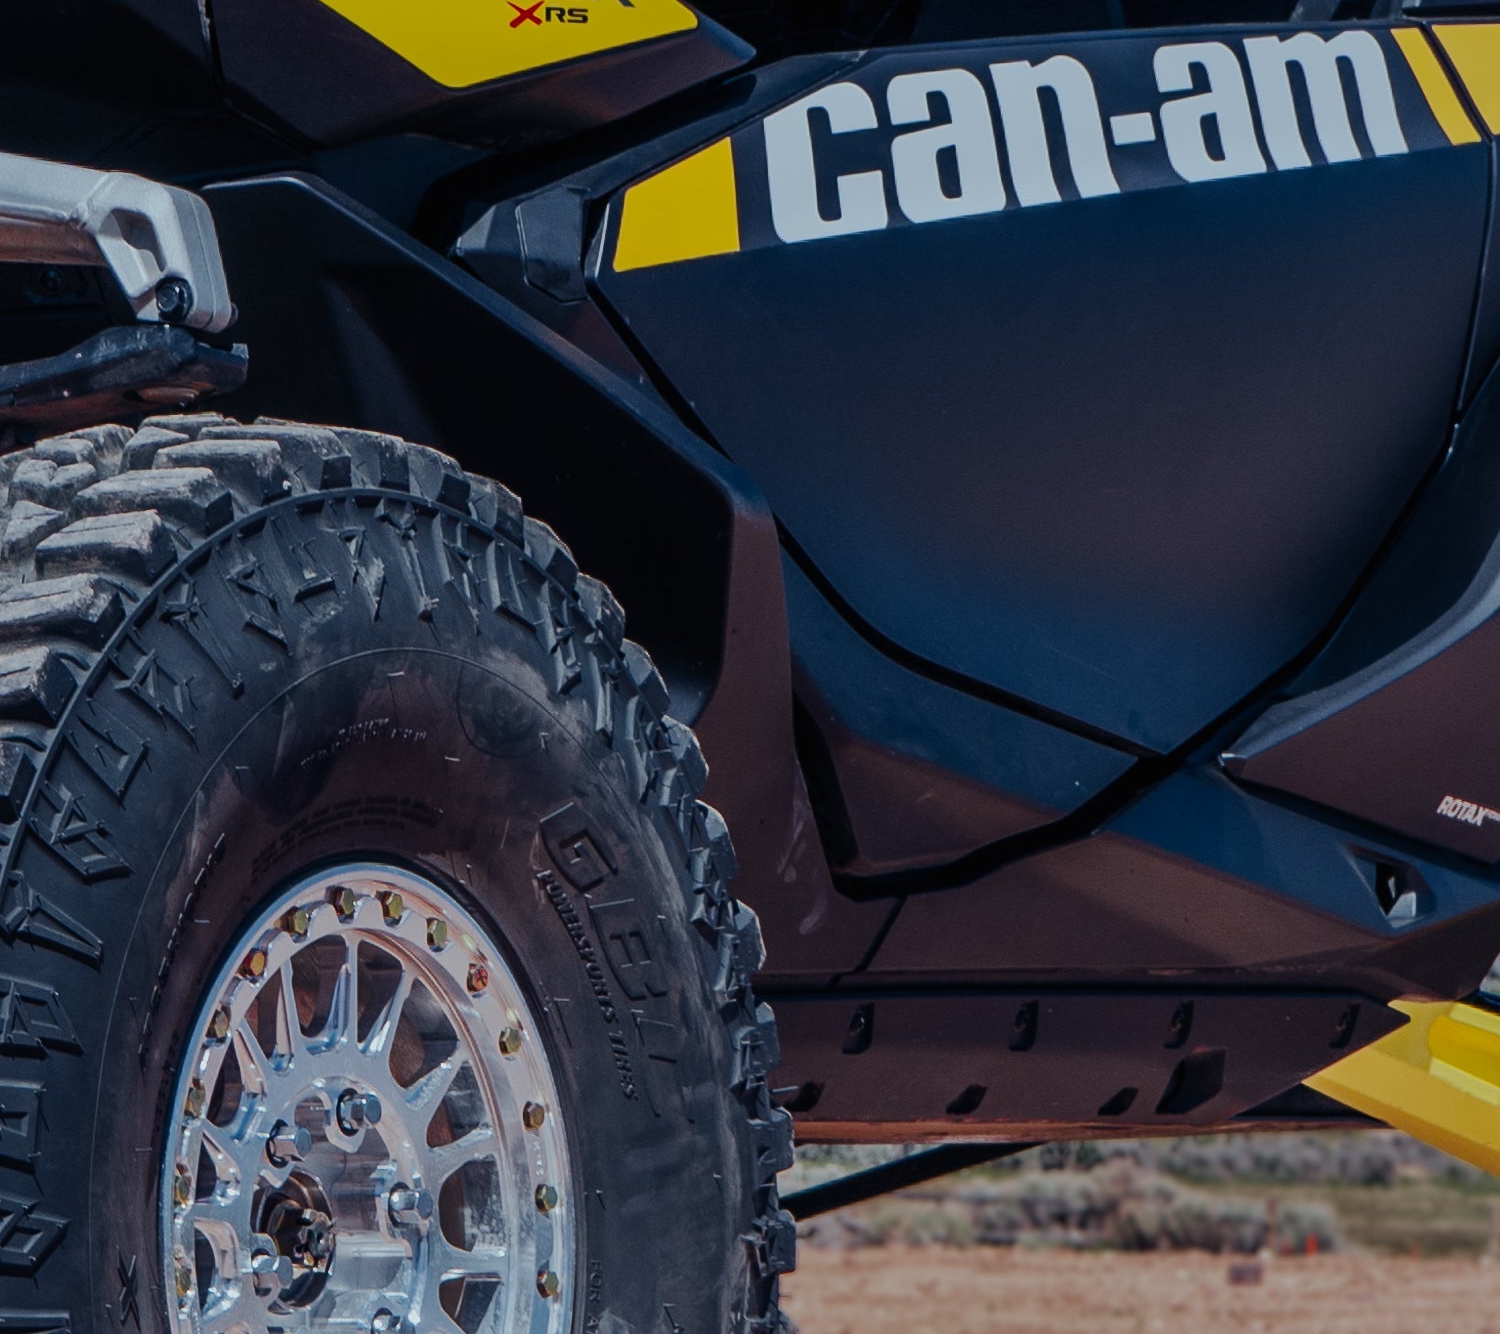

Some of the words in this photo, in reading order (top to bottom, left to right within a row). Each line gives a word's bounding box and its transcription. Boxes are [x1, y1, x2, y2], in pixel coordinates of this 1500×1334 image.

[509, 0, 589, 28] XRS
[762, 30, 1408, 244] can-am
[1436, 795, 1487, 827] ROTAX
[536, 869, 620, 1025] POWERSPORTS
[590, 1259, 602, 1302] FOR
